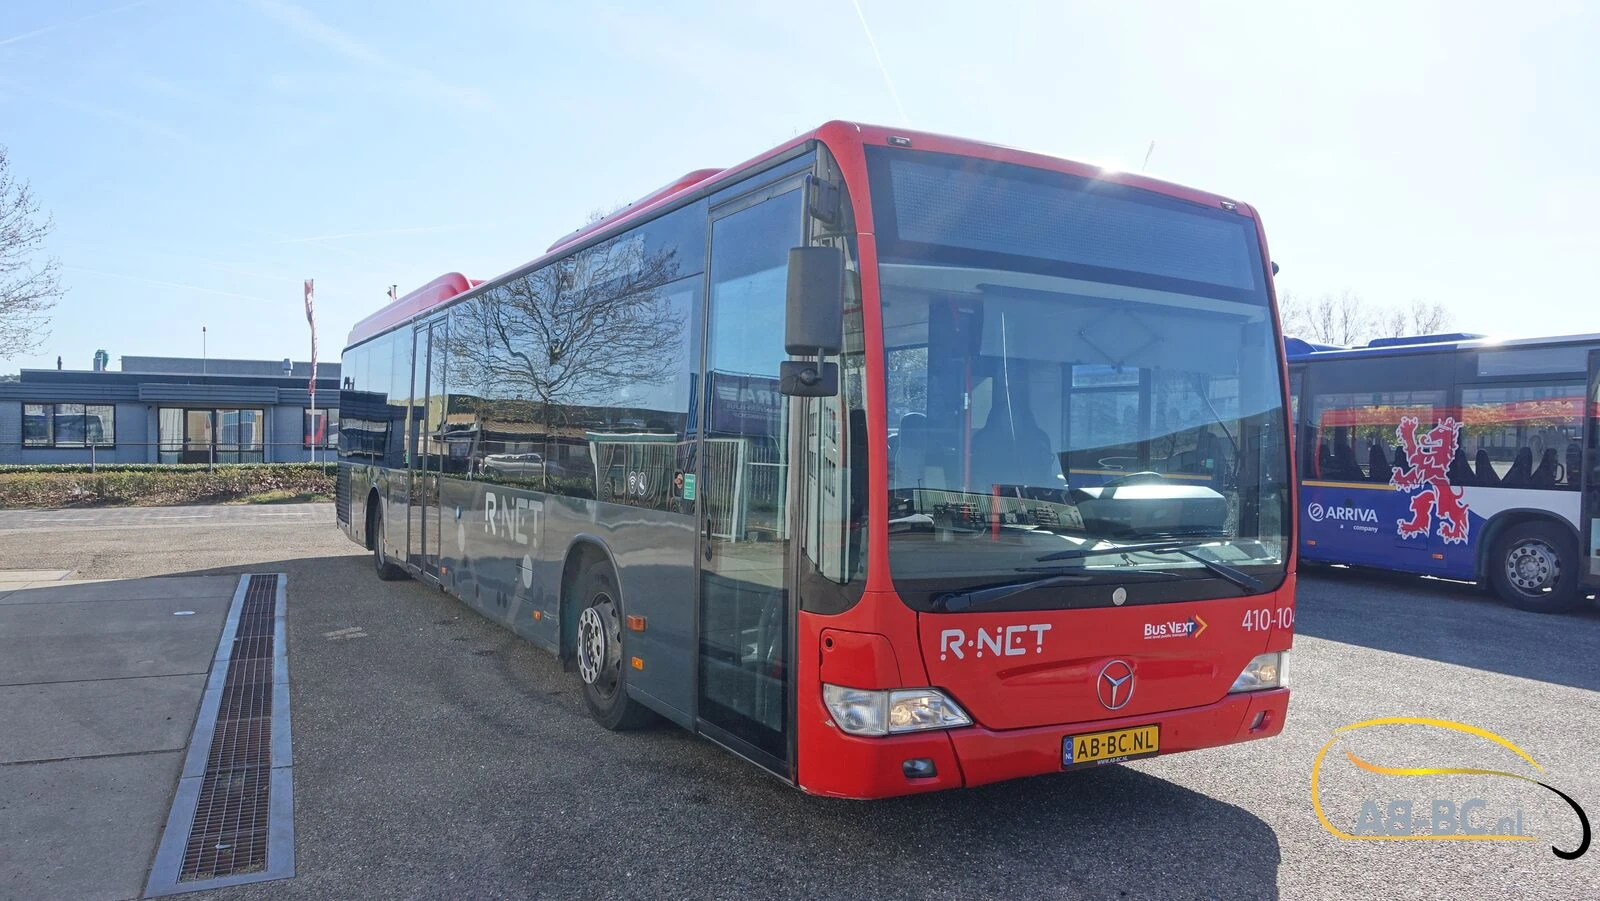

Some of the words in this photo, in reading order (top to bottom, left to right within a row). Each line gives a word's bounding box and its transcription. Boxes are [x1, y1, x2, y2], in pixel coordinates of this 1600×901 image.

[1325, 505, 1378, 523] ARRIVA
[1353, 525, 1378, 533] company
[1242, 607, 1295, 631] 410-10
[1077, 731, 1154, 759] AB-BC.NL
